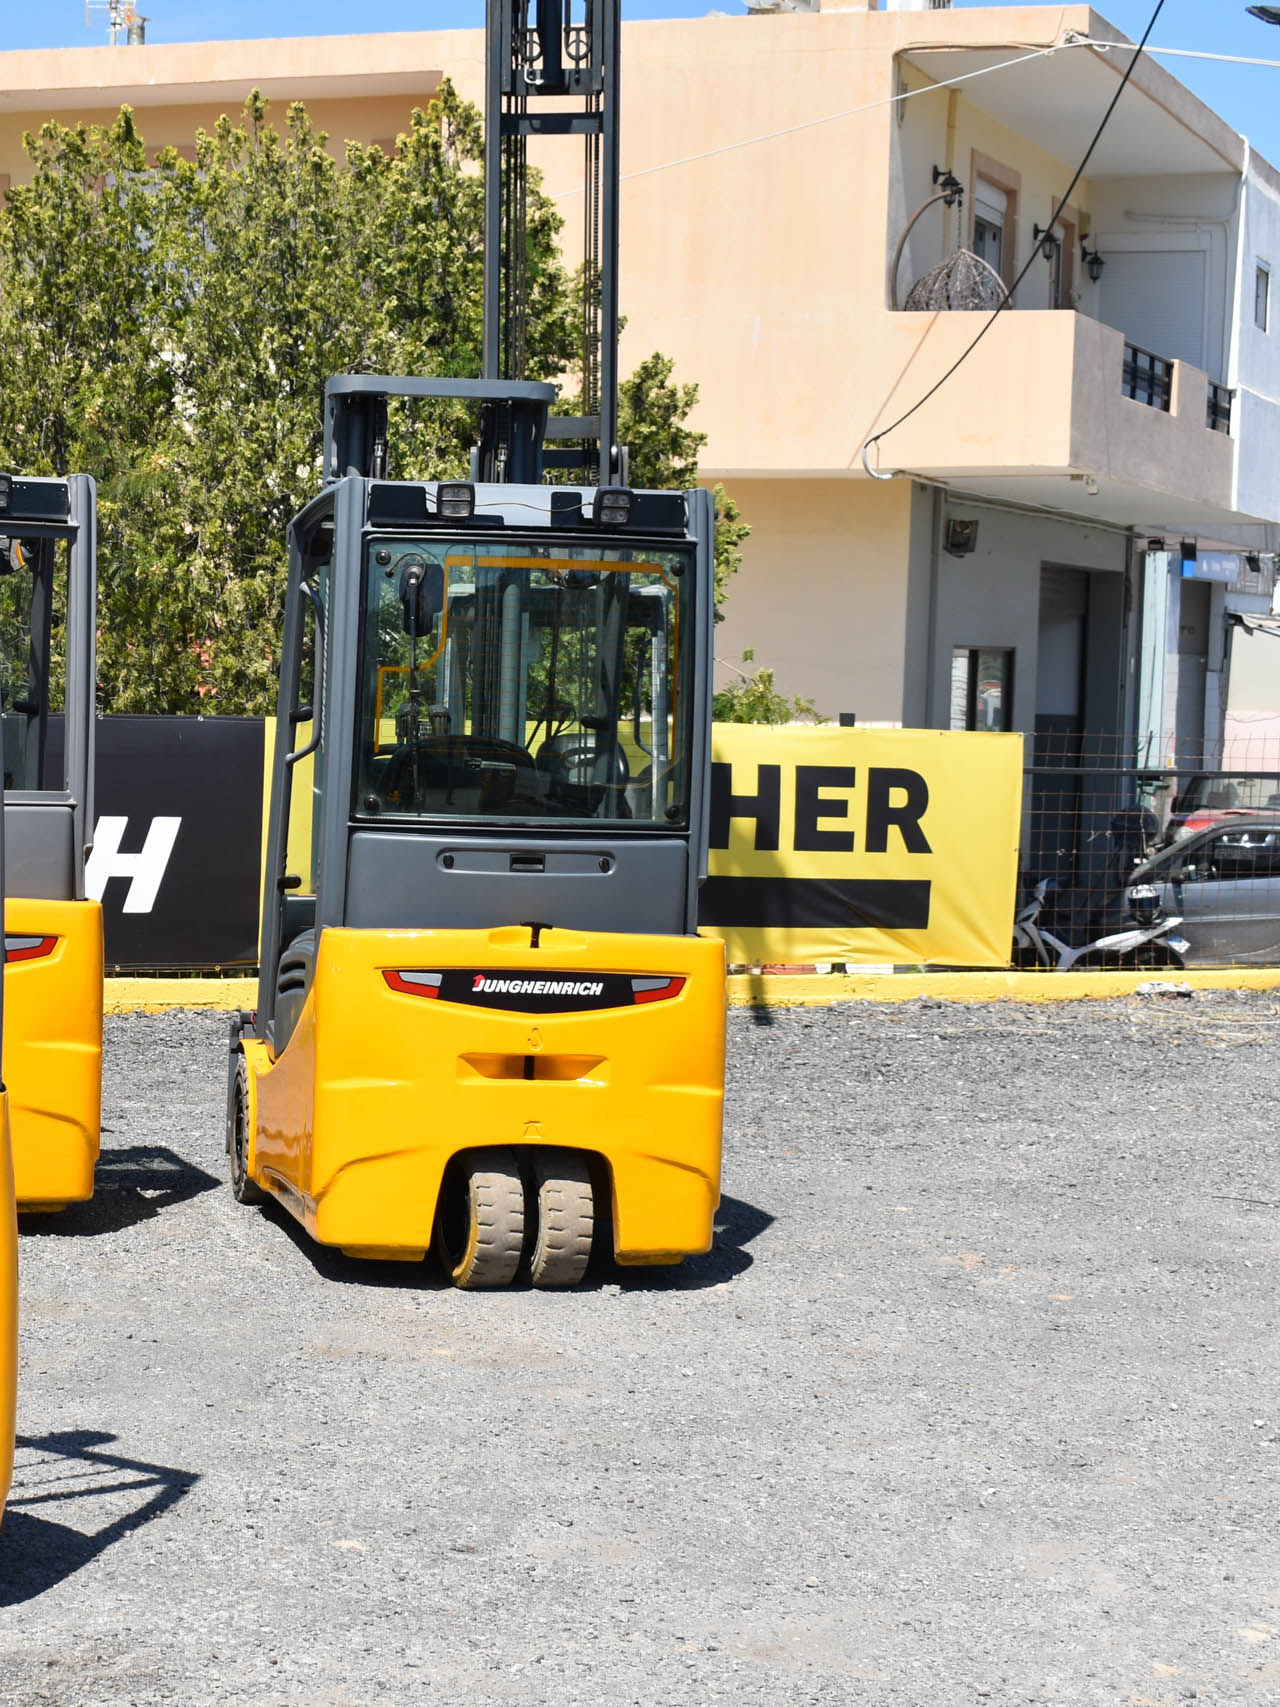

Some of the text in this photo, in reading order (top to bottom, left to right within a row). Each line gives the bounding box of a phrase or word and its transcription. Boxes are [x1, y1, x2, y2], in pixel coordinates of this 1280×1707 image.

[708, 762, 933, 854] HER
[84, 815, 182, 913] H
[472, 979, 603, 995] JUNGHEINRICH
